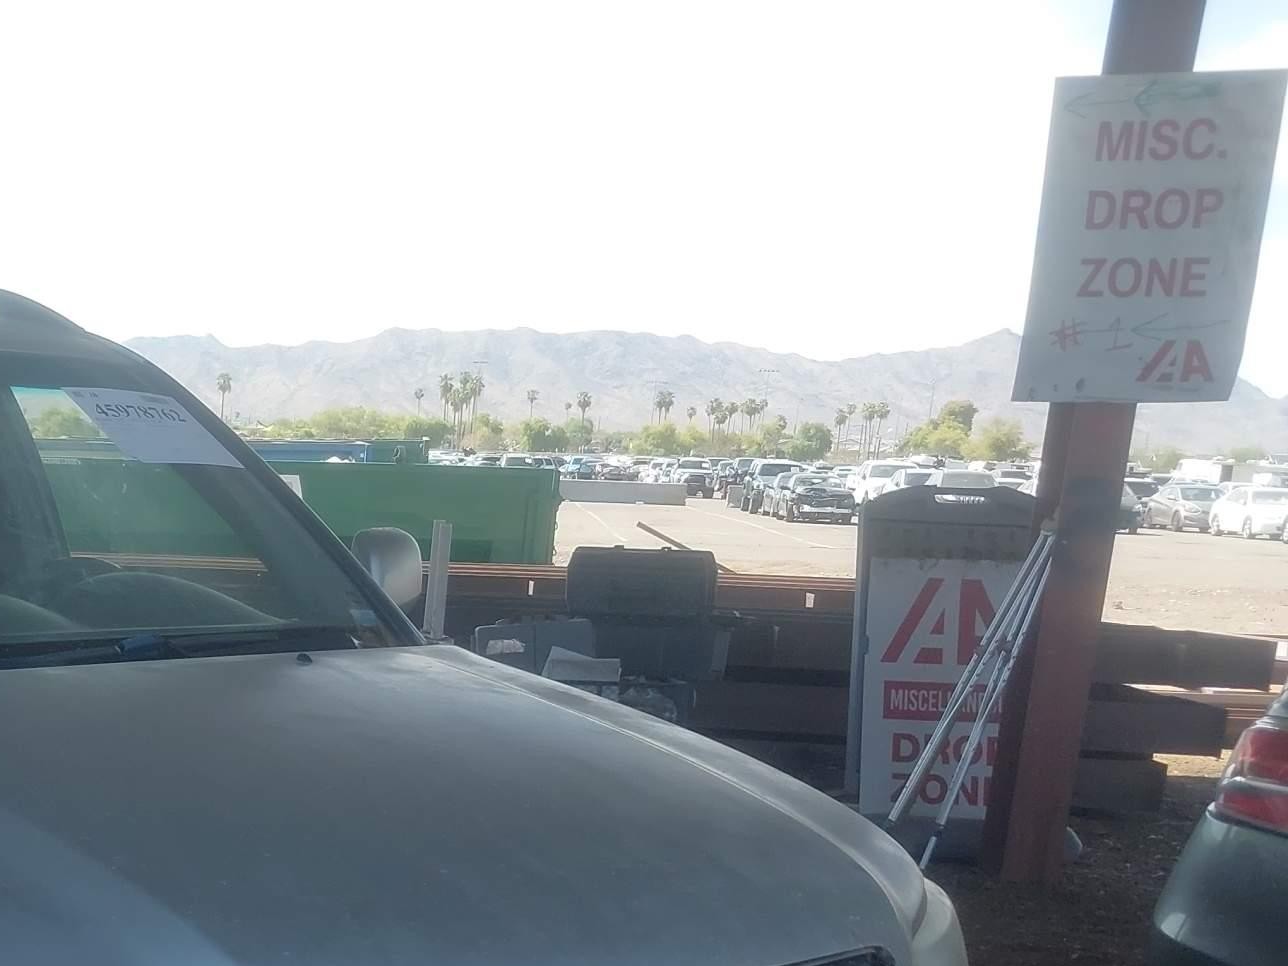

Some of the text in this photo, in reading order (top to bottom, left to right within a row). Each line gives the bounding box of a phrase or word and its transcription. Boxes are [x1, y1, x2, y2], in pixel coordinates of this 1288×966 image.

[1094, 117, 1228, 162] MISC.
[1083, 187, 1226, 231] DROP
[1075, 256, 1212, 299] ZONE
[95, 402, 187, 423] 45978762
